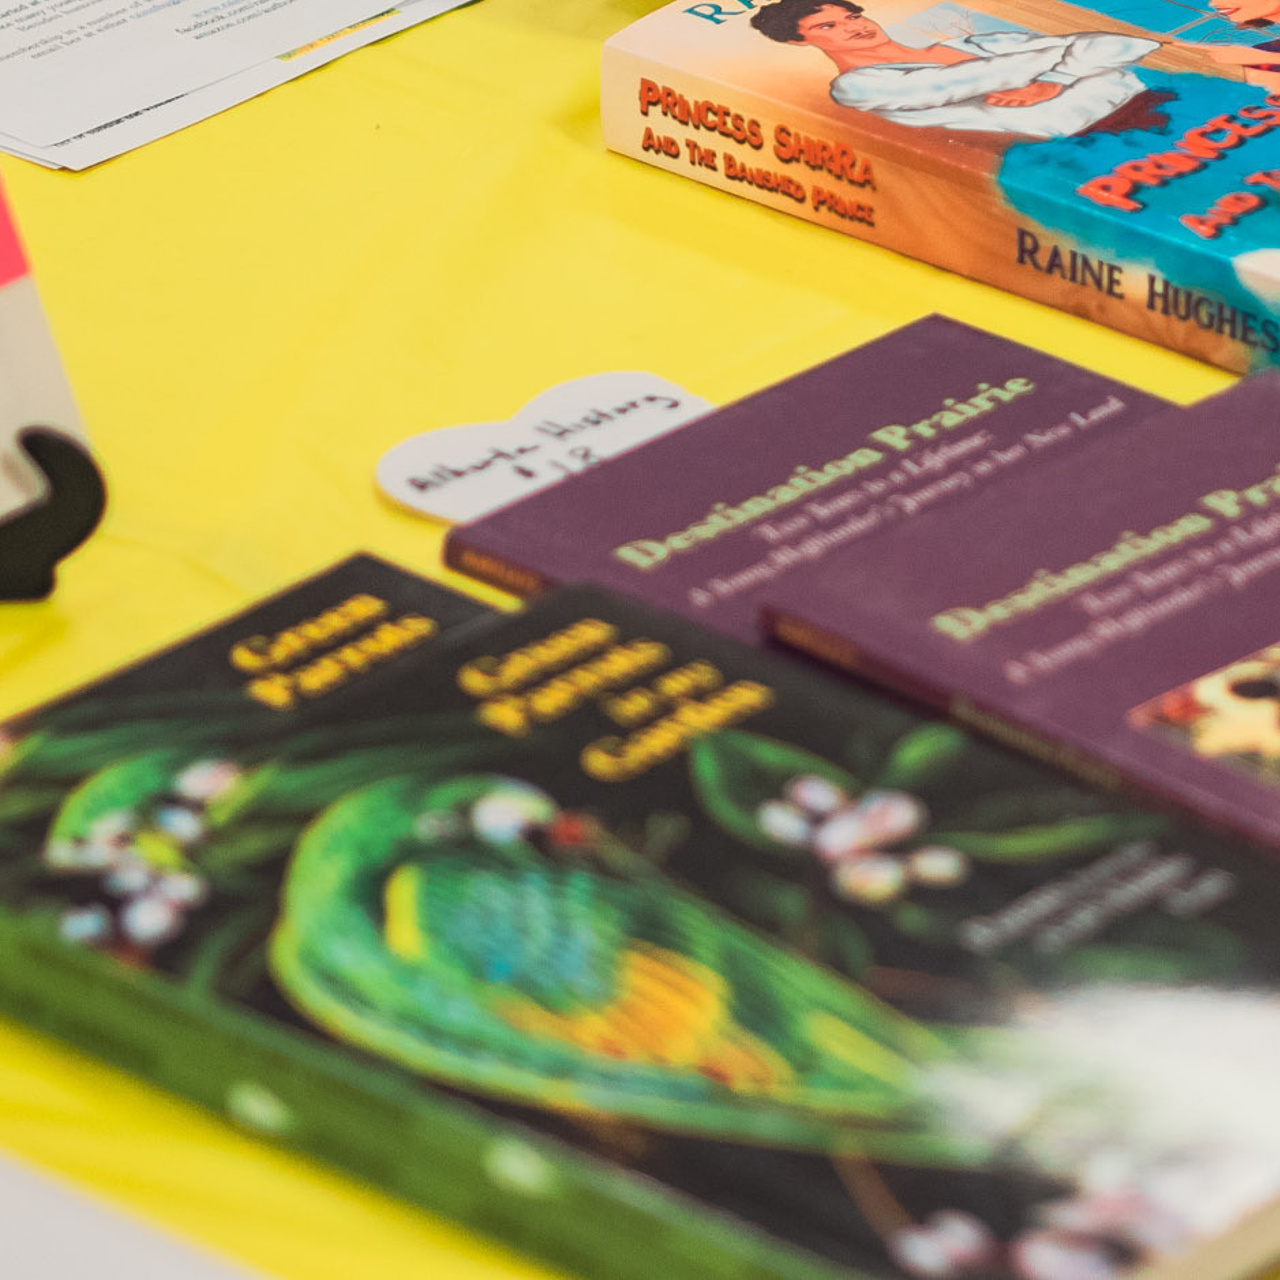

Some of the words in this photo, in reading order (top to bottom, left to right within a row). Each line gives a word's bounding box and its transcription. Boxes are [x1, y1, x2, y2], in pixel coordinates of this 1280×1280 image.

[639, 77, 764, 151] PRINCESS
[773, 124, 878, 195] SHIRRA
[1014, 226, 1126, 300] RAINE
[612, 447, 884, 571] Destination
[871, 377, 1036, 451] Prairie
[930, 511, 1213, 642] Destination
